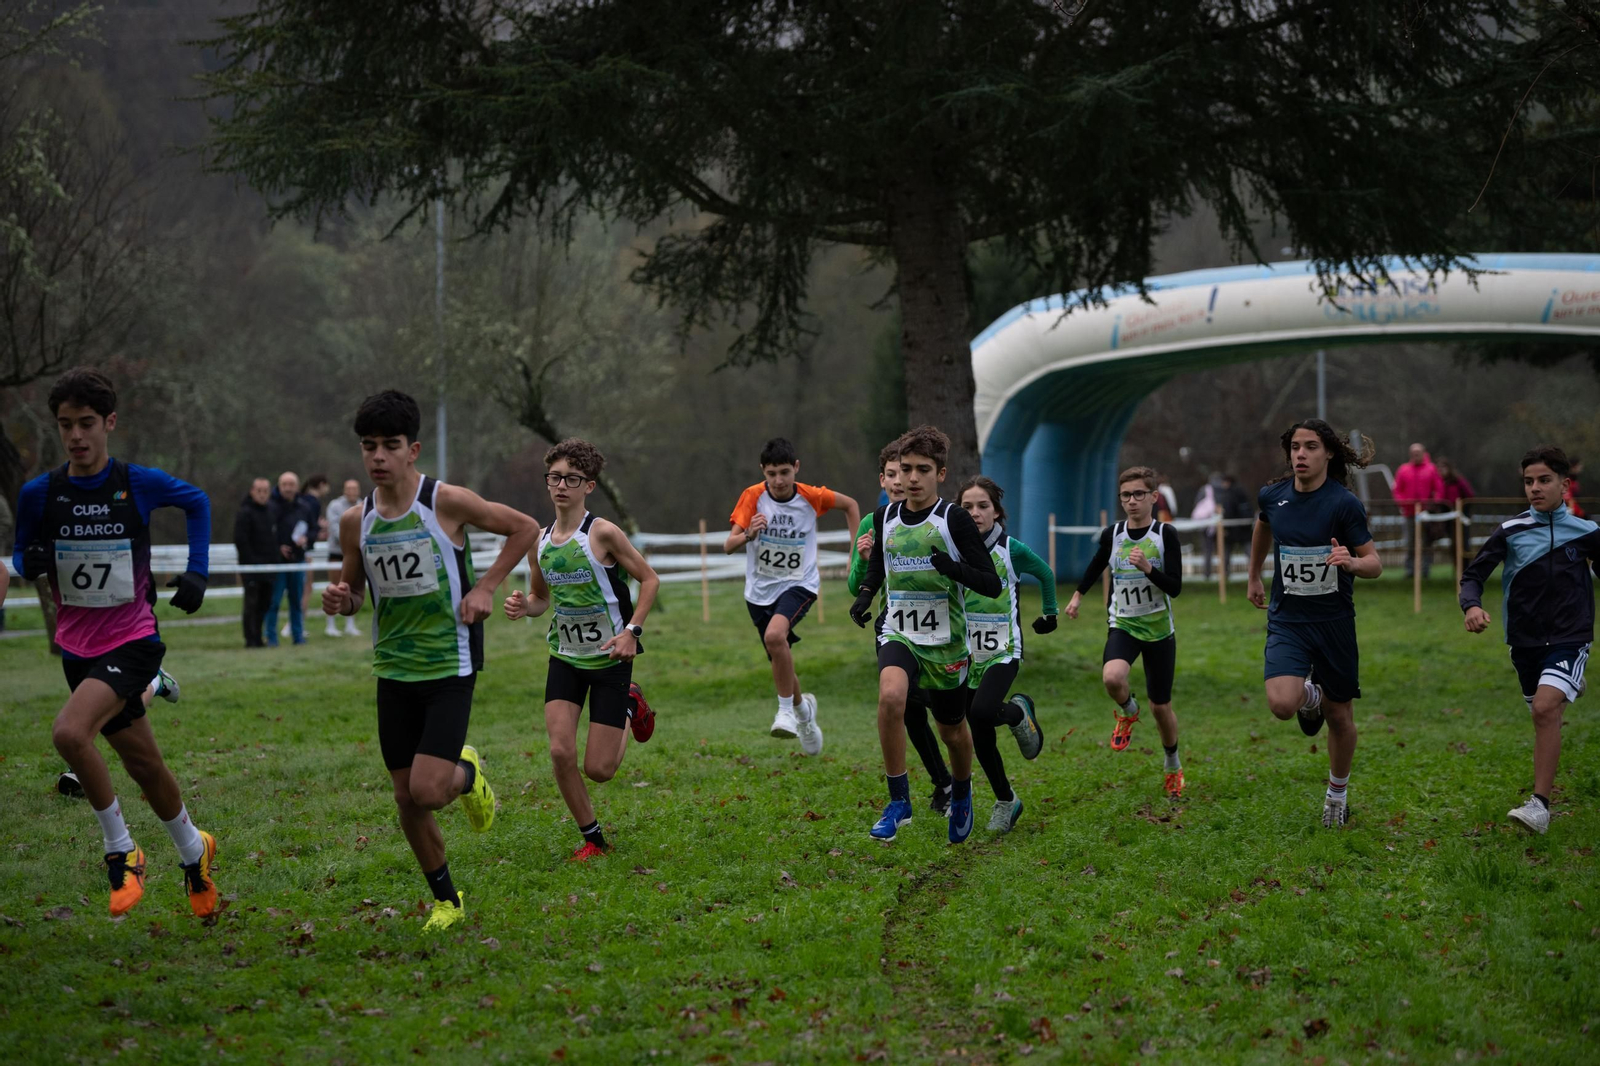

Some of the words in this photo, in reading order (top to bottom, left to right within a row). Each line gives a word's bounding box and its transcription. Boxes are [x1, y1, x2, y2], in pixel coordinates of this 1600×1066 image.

[72, 503, 111, 516] CUPA
[60, 525, 71, 537] O
[74, 522, 125, 536] BARCO
[374, 552, 423, 581] 112
[759, 549, 801, 569] 428
[71, 563, 112, 590] 67
[1283, 562, 1330, 583] 457
[1121, 585, 1153, 605] 111
[892, 609, 939, 632] 114
[560, 621, 602, 643] 113
[968, 629, 999, 651] 15
